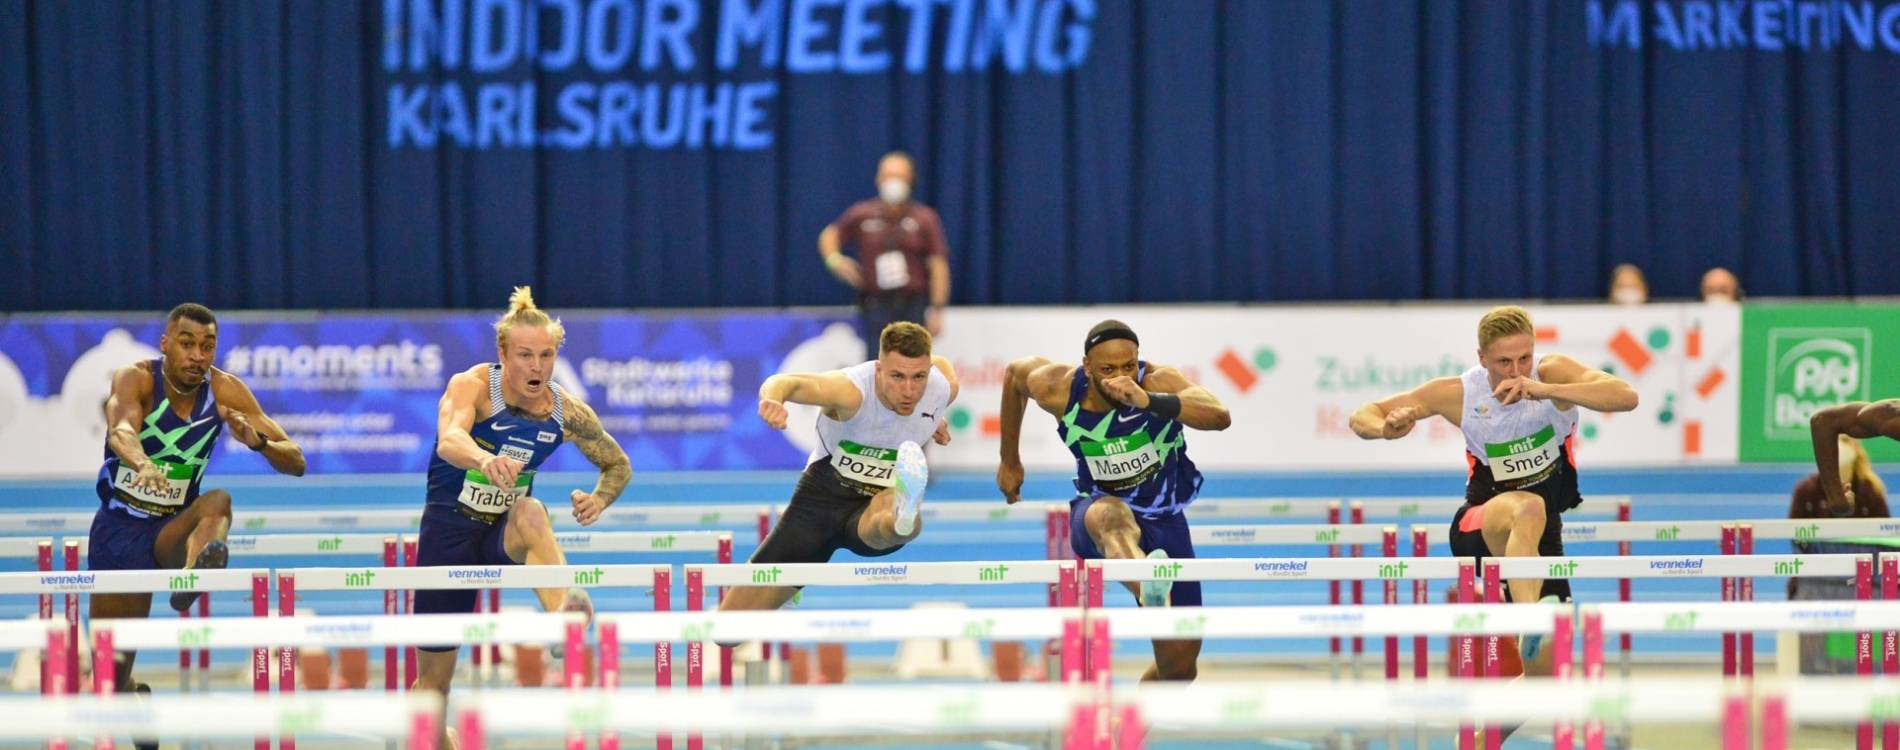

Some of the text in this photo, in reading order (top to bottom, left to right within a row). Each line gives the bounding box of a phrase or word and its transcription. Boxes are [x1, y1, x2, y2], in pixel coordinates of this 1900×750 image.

[381, 0, 1094, 73] INDOOR MEETING
[387, 81, 779, 149] KARLSRUHE
[224, 340, 443, 376] #moments
[860, 448, 890, 459] init
[1103, 438, 1129, 456] init
[1507, 437, 1537, 454] init
[1095, 452, 1150, 476] Manga
[1502, 449, 1551, 473] Smet
[854, 565, 908, 576] vennekel
[1153, 562, 1183, 579] init
[1254, 561, 1308, 571] vennekel
[1379, 561, 1409, 578] init
[1549, 559, 1579, 577] init
[1649, 558, 1704, 569] vennekel
[1774, 558, 1804, 576] init
[40, 574, 96, 584] vennekel
[345, 569, 376, 587] init
[448, 568, 503, 579] vennekel
[574, 567, 605, 585] init
[752, 566, 783, 584] init
[979, 564, 1009, 581] init
[169, 573, 200, 590] init
